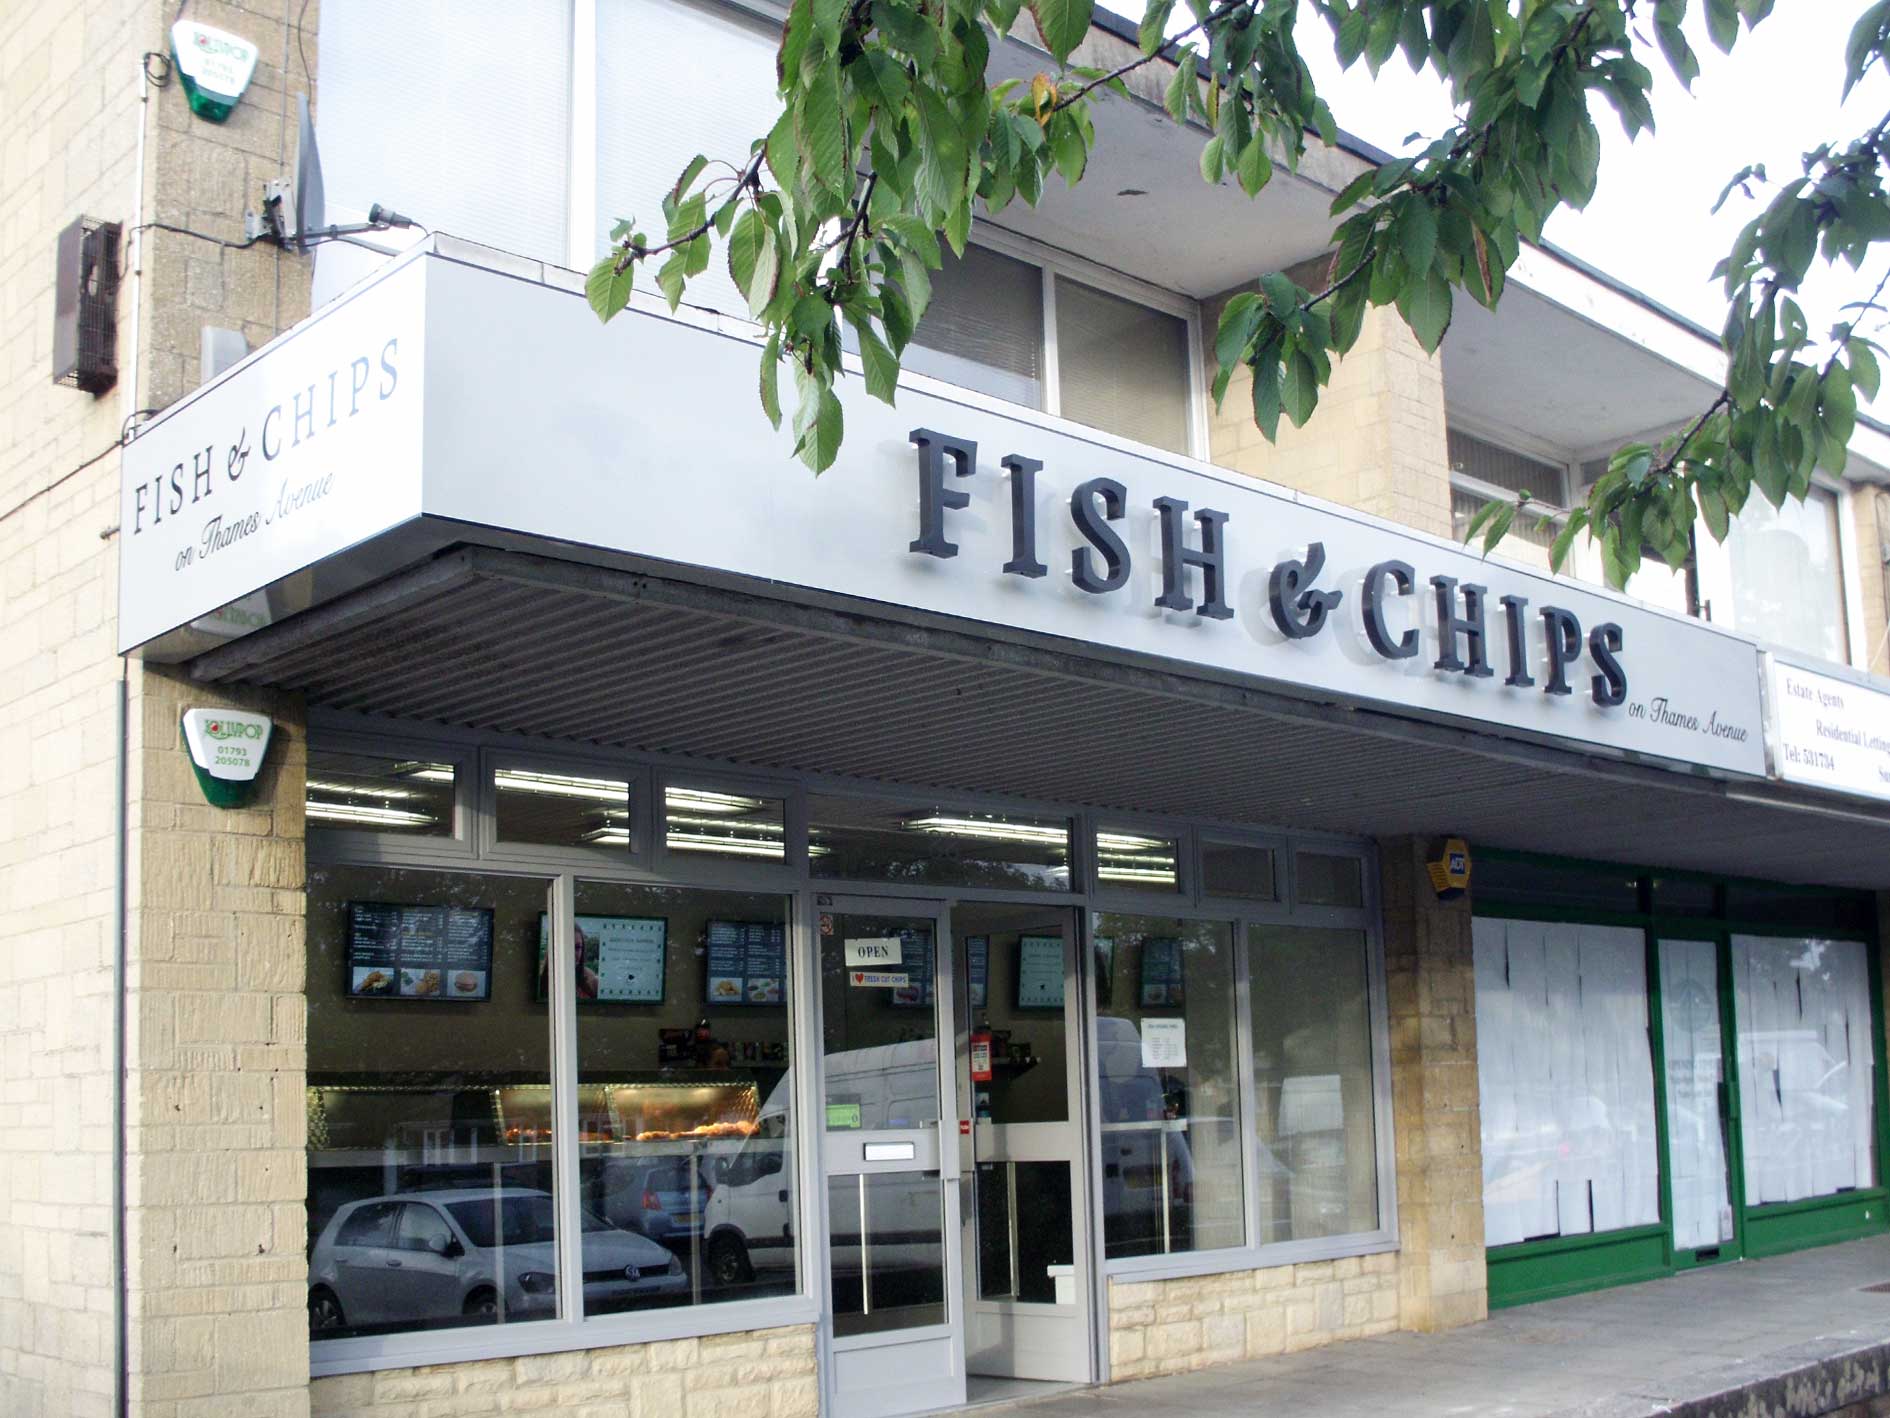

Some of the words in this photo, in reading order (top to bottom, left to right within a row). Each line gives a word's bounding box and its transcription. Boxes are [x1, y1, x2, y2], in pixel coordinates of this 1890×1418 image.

[134, 445, 213, 535] FISH
[228, 427, 251, 481] &
[262, 338, 398, 461] CHIPS
[175, 549, 193, 572] on
[200, 511, 262, 559] Thames
[265, 472, 335, 525] Avenue
[909, 427, 1234, 620] FISH
[1268, 541, 1343, 640] &
[1362, 559, 1627, 706] CHIPS
[1786, 677, 1813, 701] Estate
[1817, 687, 1844, 709] Agents
[1629, 702, 1645, 719] on
[1650, 697, 1699, 731] Thames
[1702, 711, 1748, 742] Avenue
[1816, 719, 1861, 745] Residential
[1784, 743, 1801, 763] Tel:
[857, 945, 889, 958] OPEN
